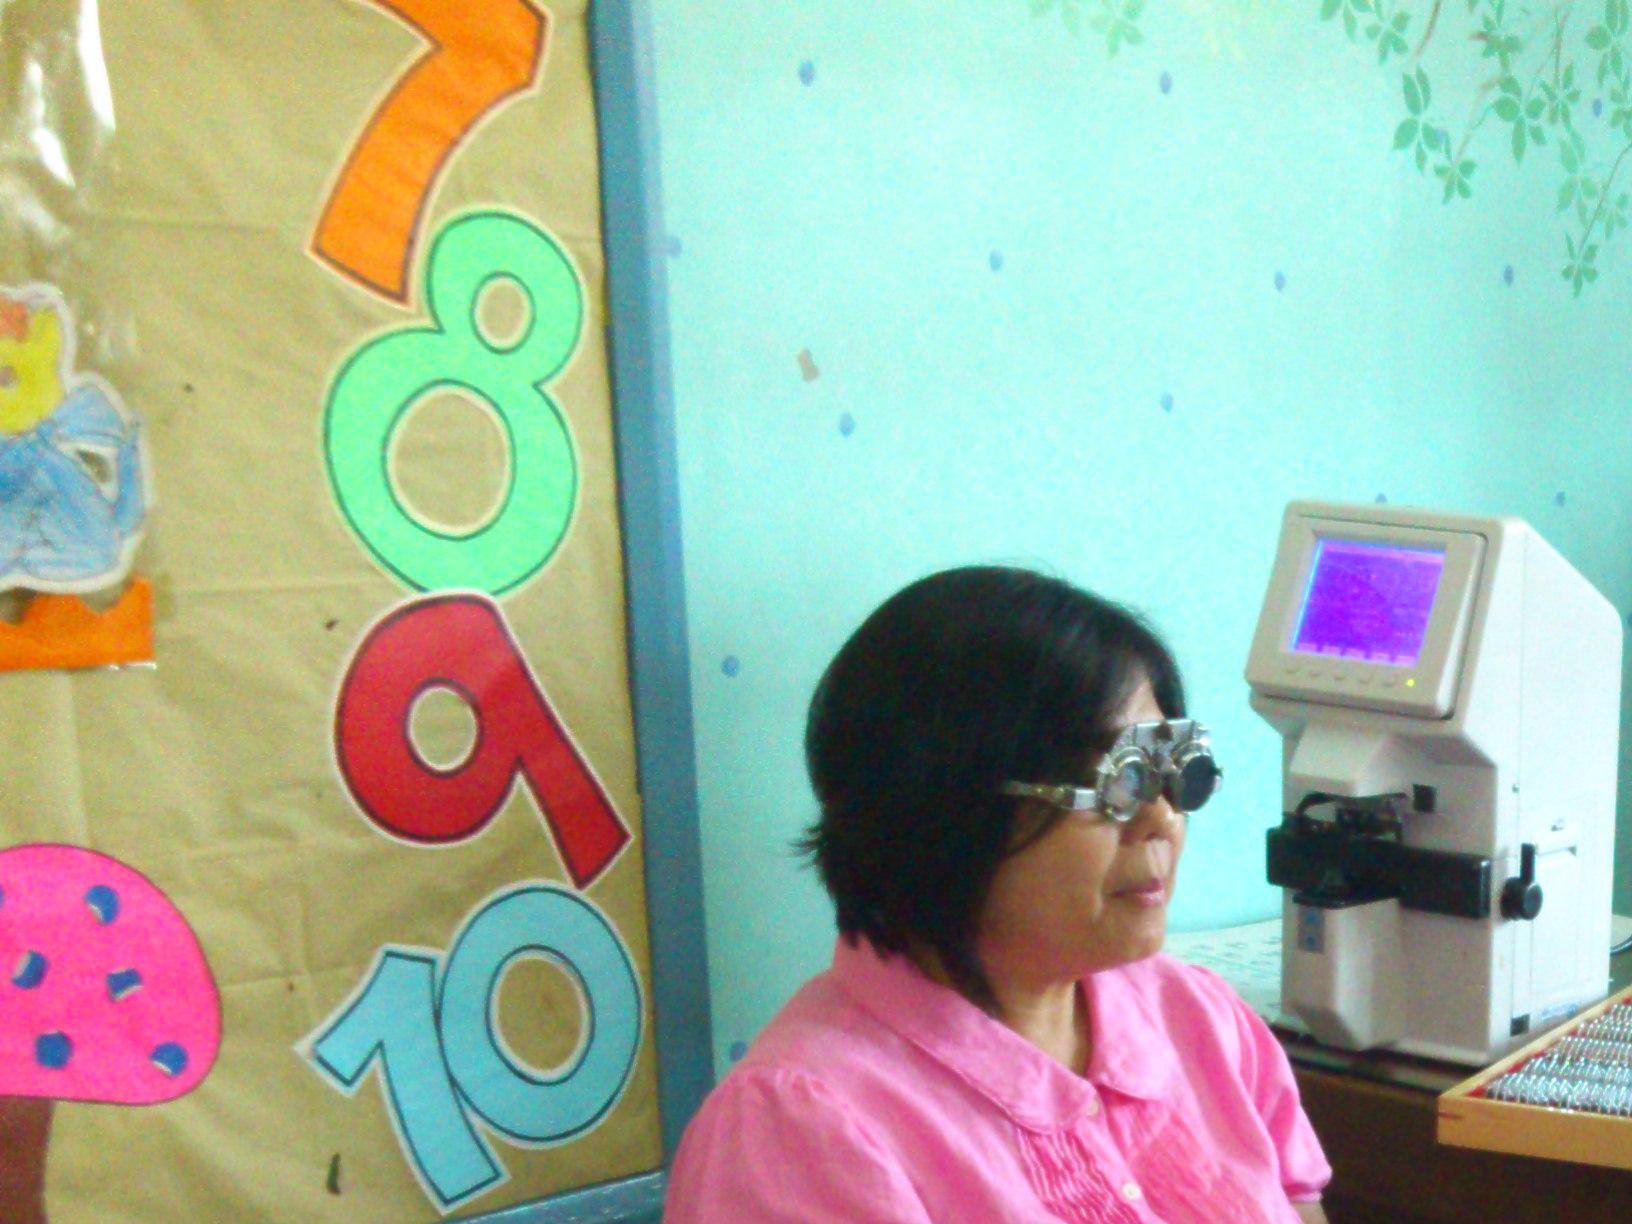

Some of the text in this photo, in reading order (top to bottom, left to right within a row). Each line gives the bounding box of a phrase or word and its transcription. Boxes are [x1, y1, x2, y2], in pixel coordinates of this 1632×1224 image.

[308, 0, 551, 306] 7
[322, 209, 586, 597] 8
[334, 596, 632, 891] 9
[310, 884, 642, 1208] 10
